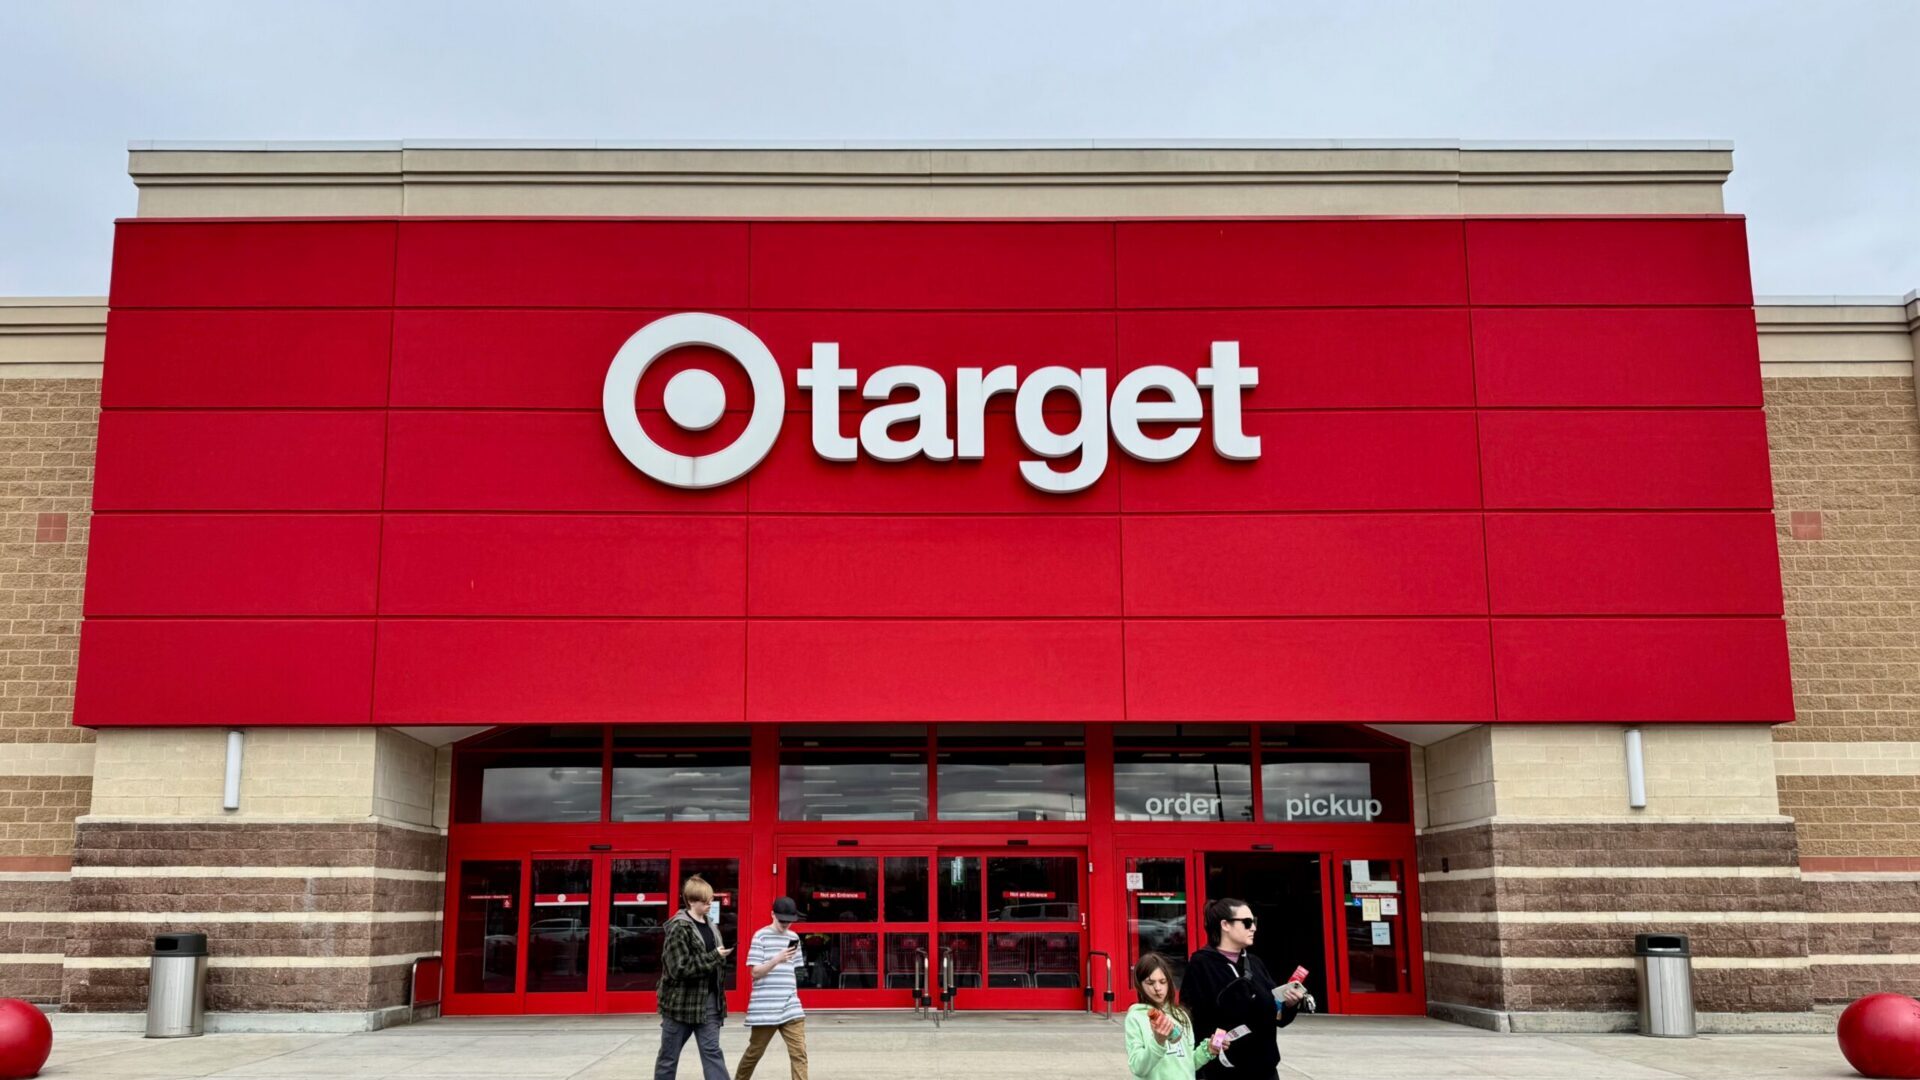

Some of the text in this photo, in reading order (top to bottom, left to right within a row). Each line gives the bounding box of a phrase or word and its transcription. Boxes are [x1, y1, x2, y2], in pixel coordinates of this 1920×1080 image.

[797, 341, 1261, 493] target
[1145, 793, 1382, 821] order pickup
